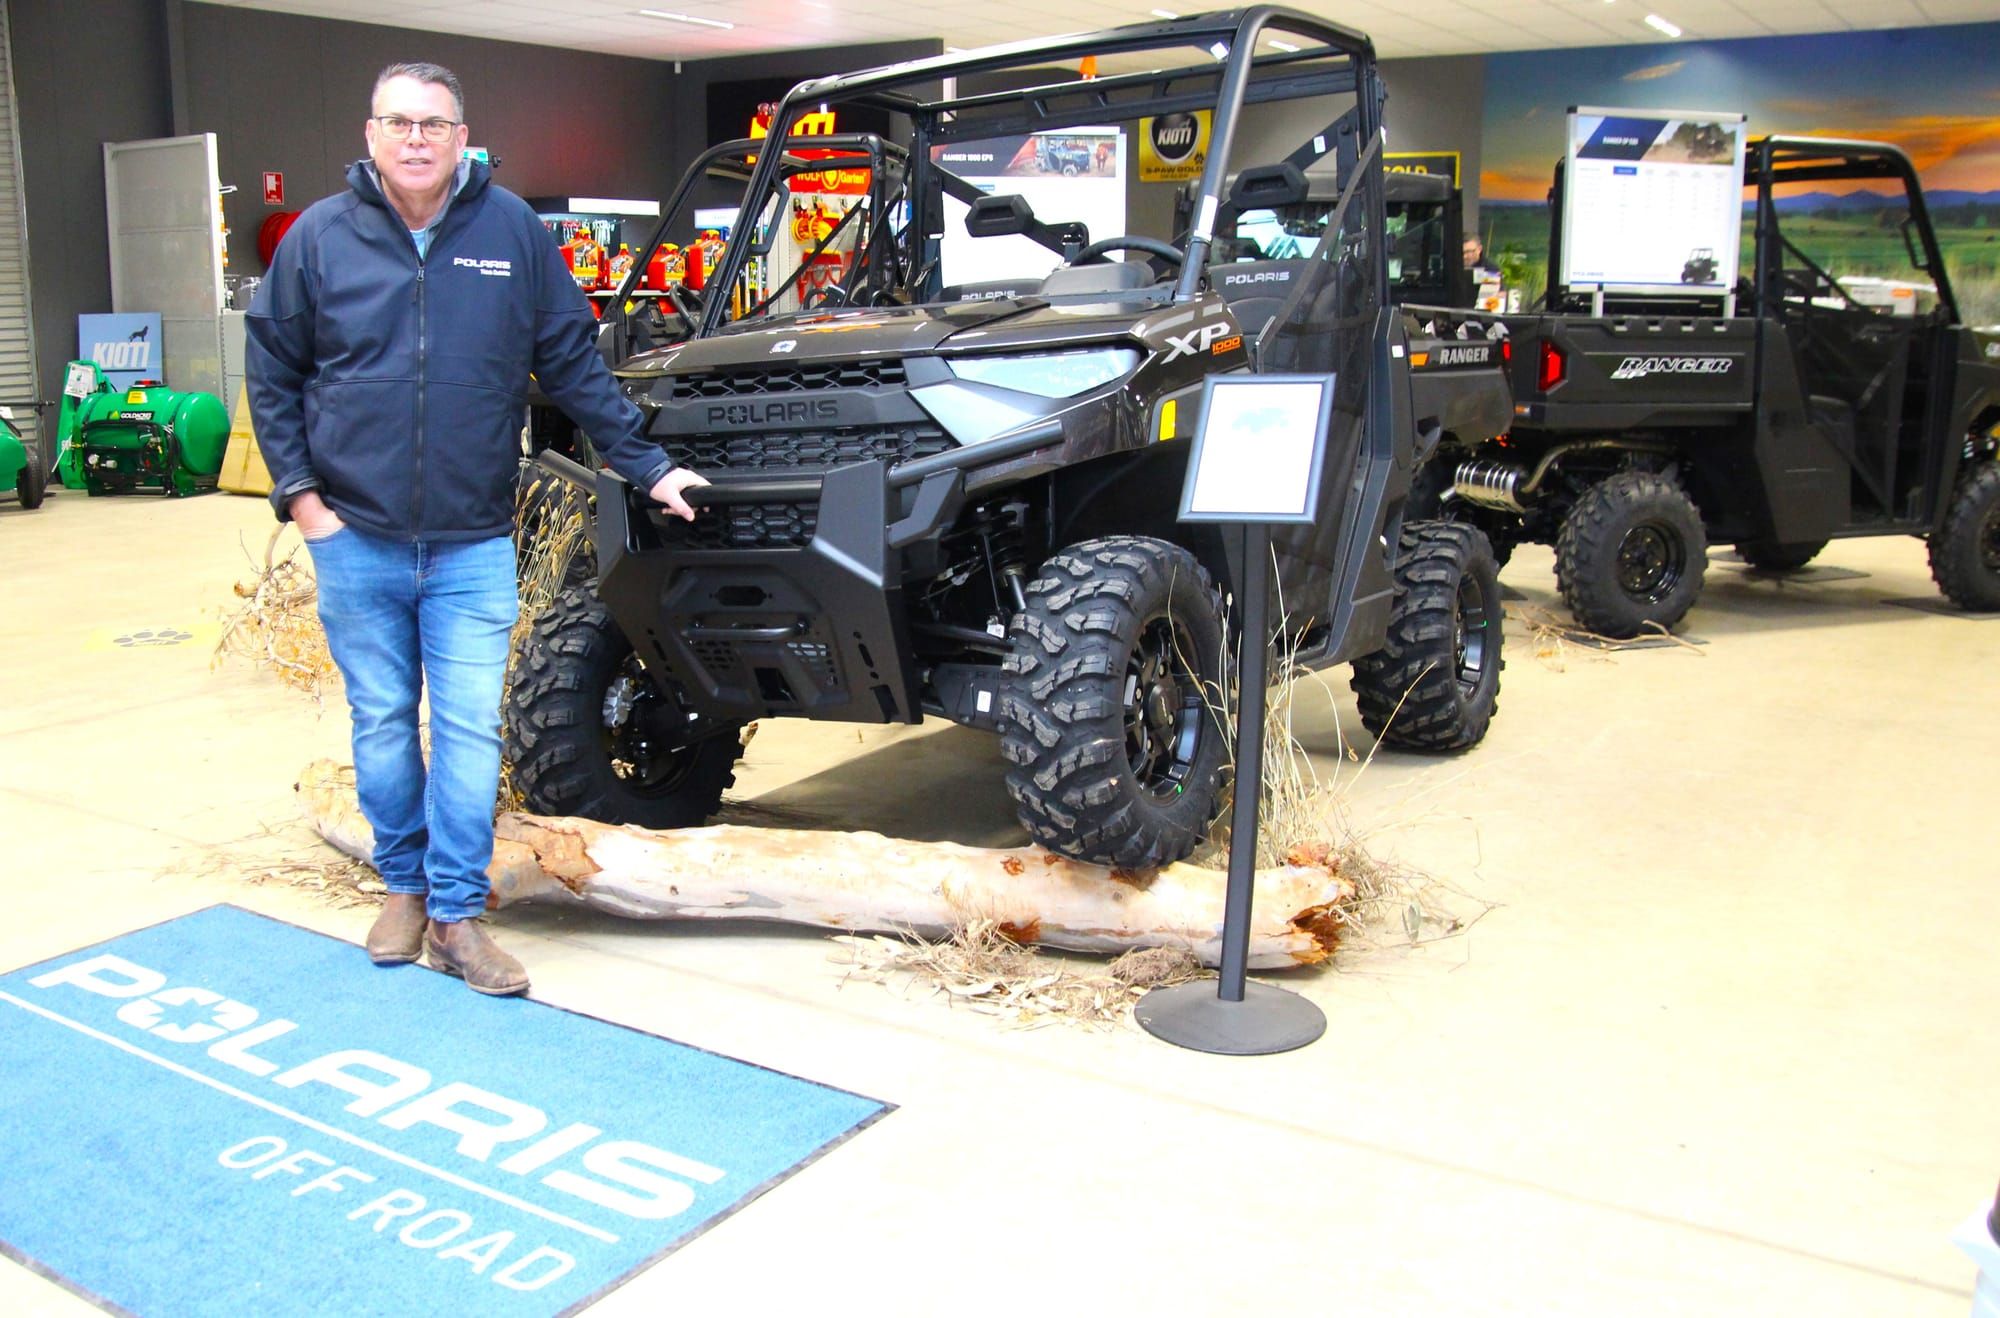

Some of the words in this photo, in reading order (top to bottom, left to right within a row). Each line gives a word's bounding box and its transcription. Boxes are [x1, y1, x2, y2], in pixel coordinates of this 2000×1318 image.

[1157, 127, 1192, 146] KIOTI
[943, 153, 966, 161] RANGER
[453, 257, 511, 270] POLARIS
[1225, 271, 1290, 286] POLARIS
[1160, 321, 1231, 365] XP
[1212, 335, 1241, 353] 1000
[92, 341, 150, 369] KIOTI
[1439, 347, 1489, 365] RANGER
[1619, 357, 1733, 373] RANGER
[707, 400, 839, 425] POLARIS
[28, 954, 726, 1219] POLARIS
[218, 1135, 376, 1198] OFF
[348, 1191, 576, 1291] ROAD
